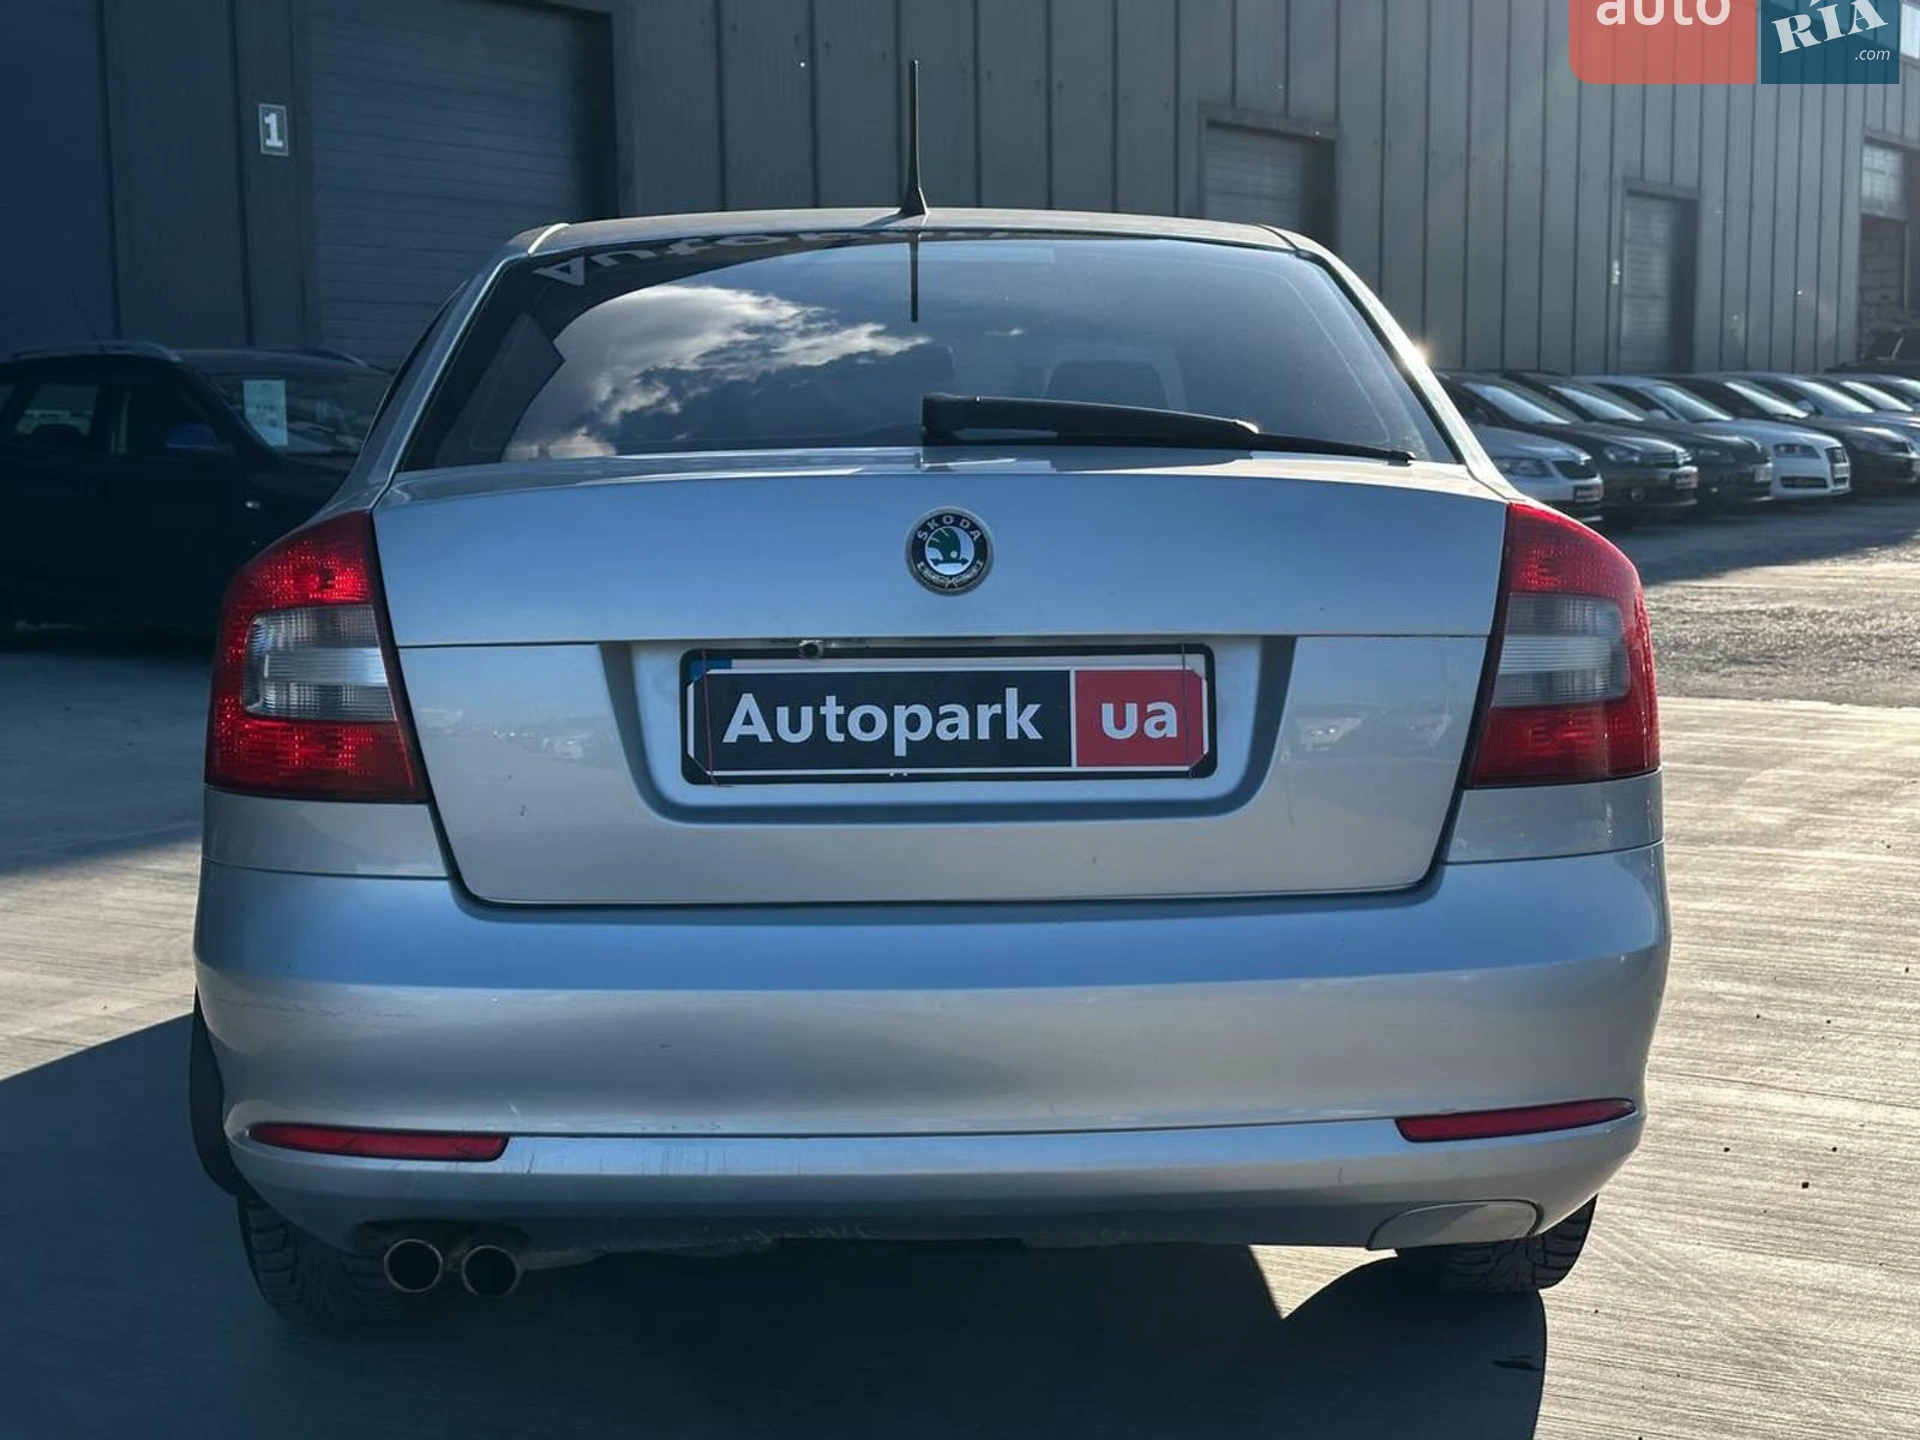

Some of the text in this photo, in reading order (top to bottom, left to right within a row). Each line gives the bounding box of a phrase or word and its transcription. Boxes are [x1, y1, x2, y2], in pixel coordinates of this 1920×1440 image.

[264, 112, 284, 147] 1
[722, 687, 1178, 757] Autopark ua
